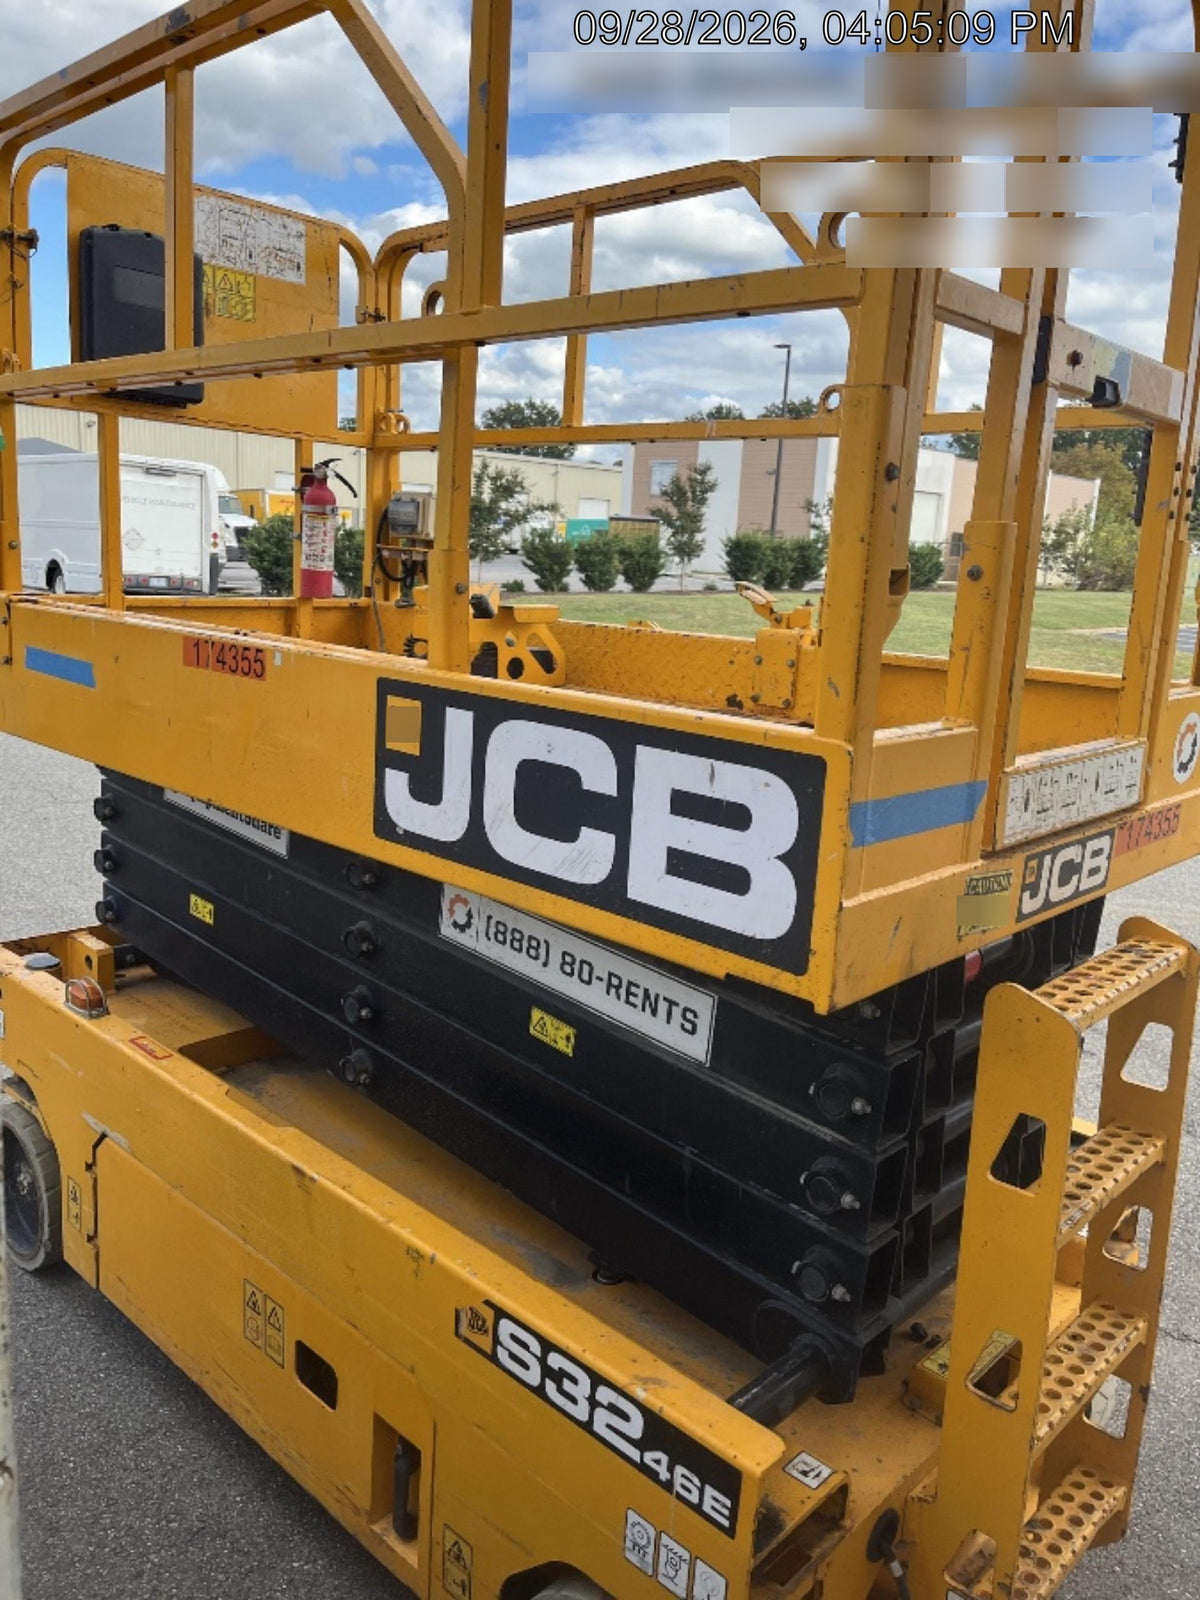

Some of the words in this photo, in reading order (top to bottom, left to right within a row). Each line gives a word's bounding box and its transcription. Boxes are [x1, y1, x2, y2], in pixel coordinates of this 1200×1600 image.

[192, 637, 266, 678] 174355
[384, 706, 799, 940] JCB
[1021, 834, 1112, 915] JCB
[484, 914, 551, 967] (888)
[558, 950, 699, 1036] 80-RENTS
